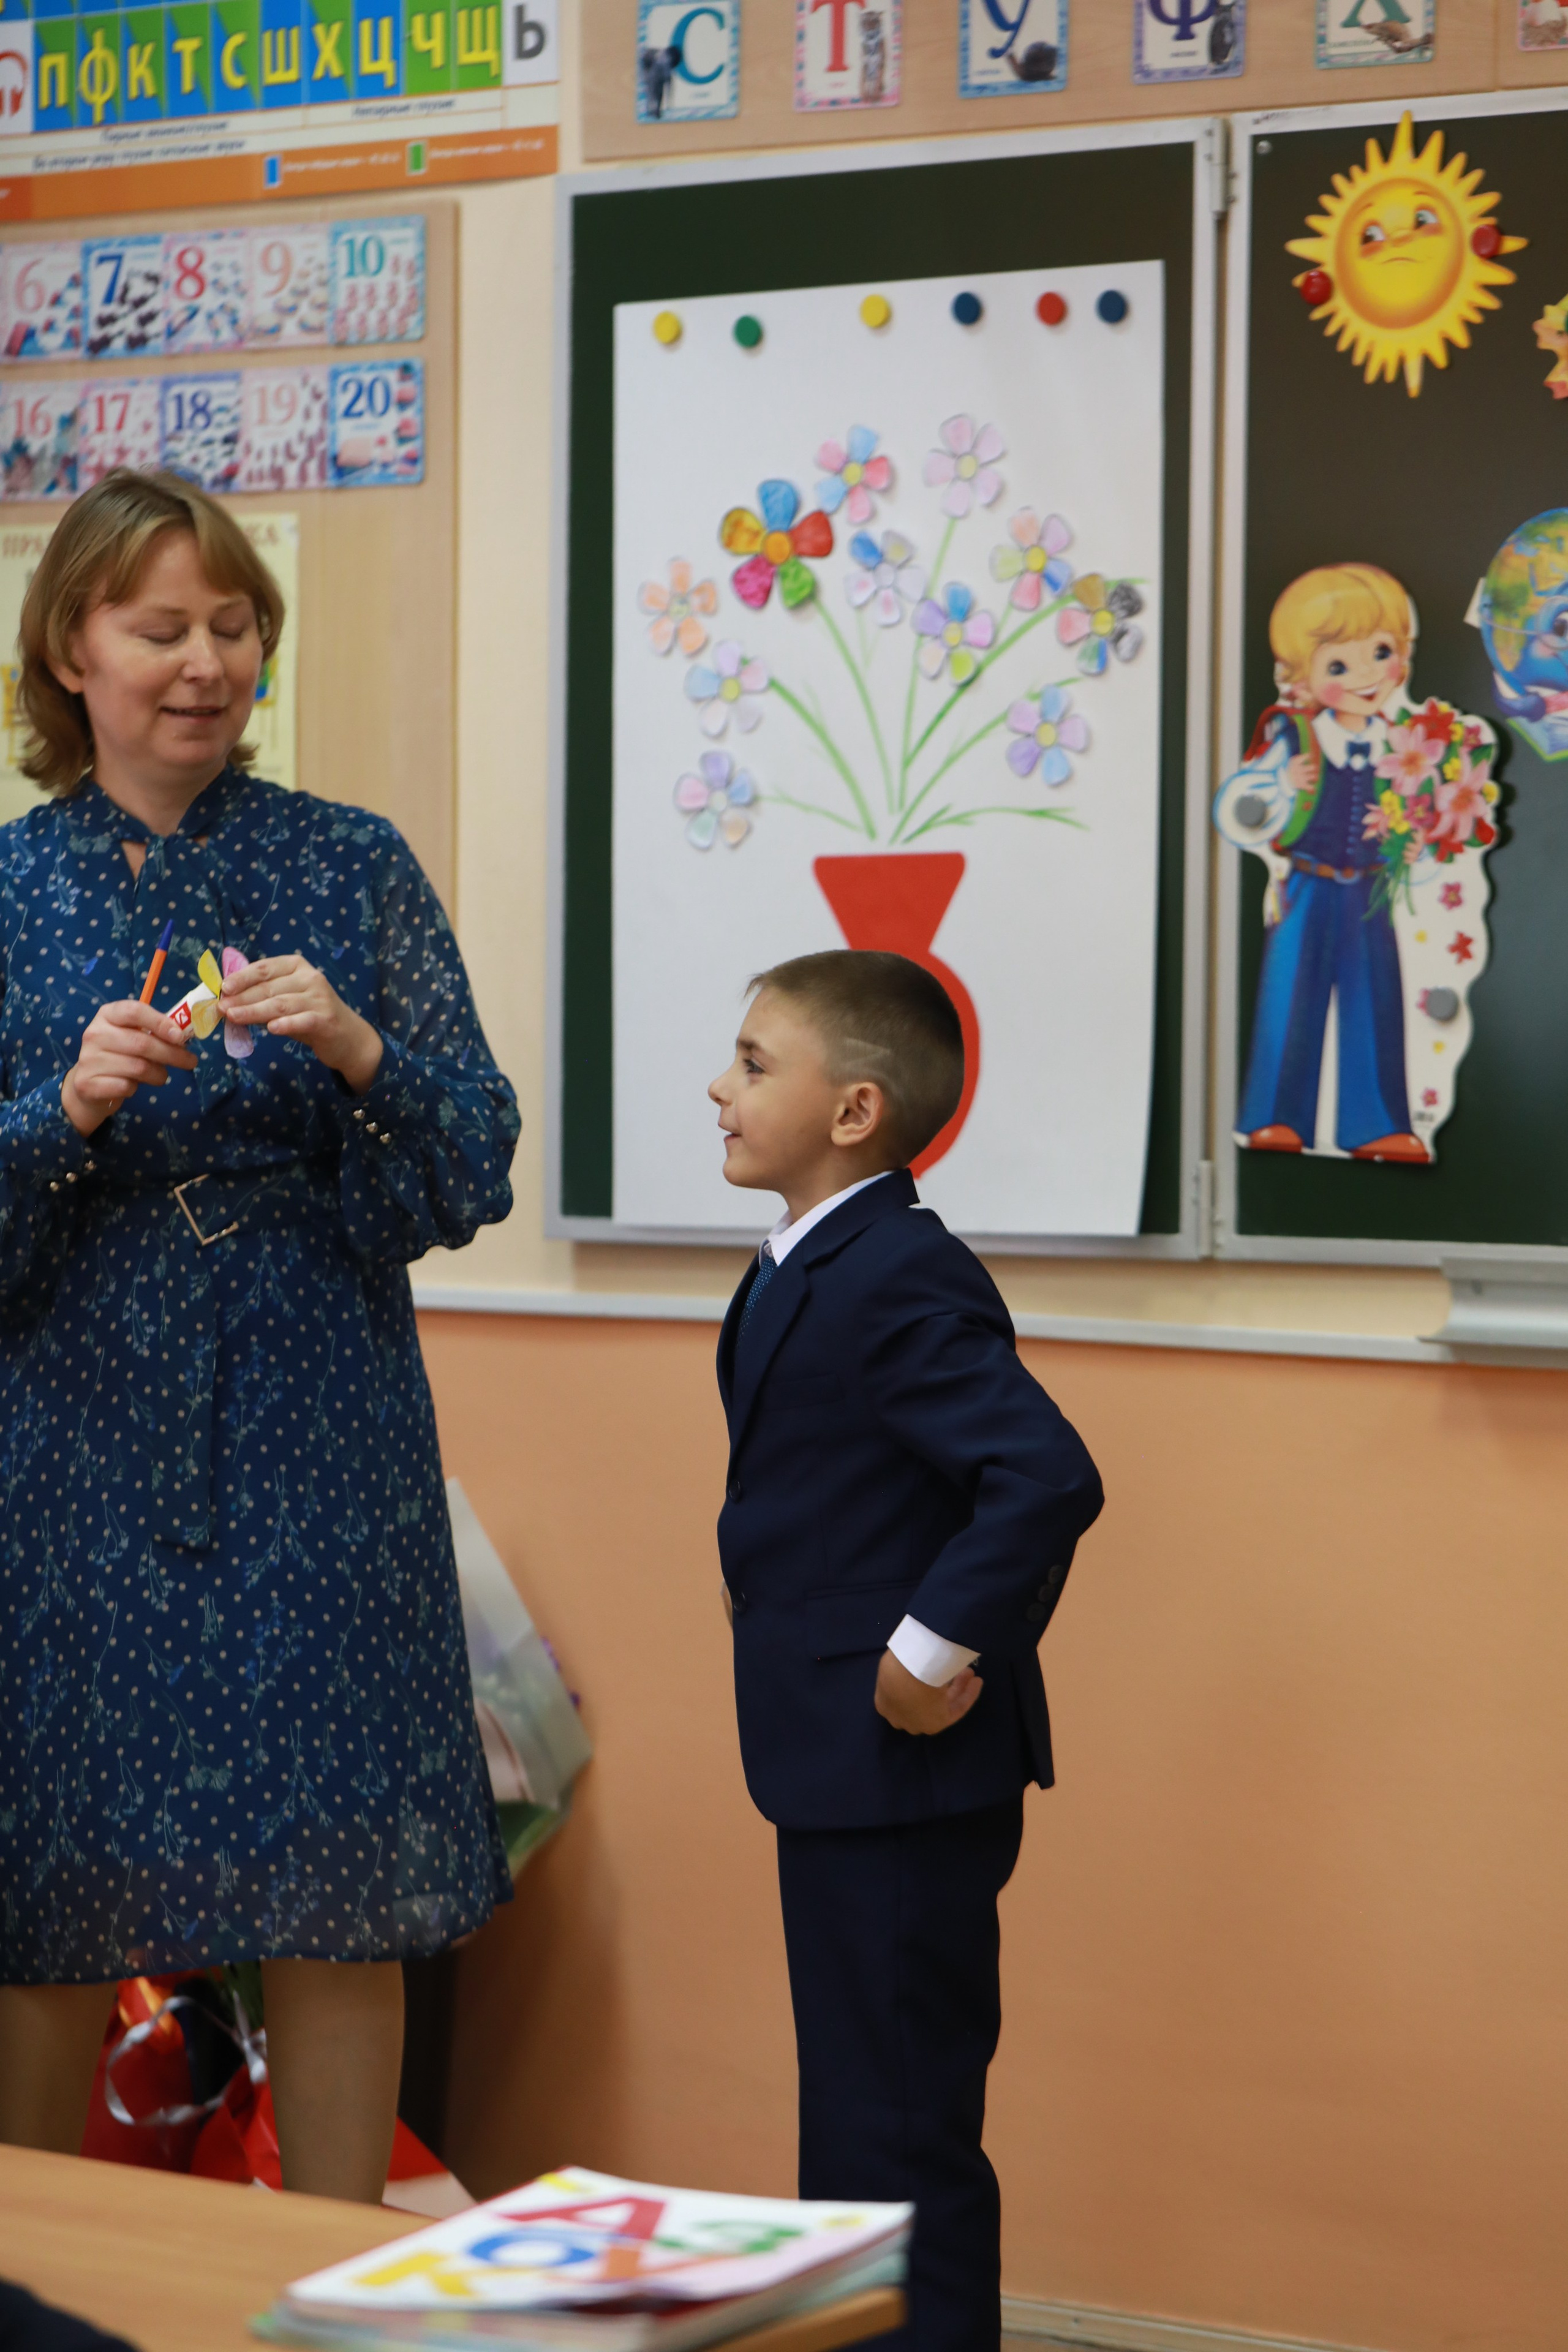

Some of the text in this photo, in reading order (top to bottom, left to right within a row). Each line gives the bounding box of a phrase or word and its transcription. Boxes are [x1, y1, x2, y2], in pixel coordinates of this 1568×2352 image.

[670, 7, 725, 85] С
[811, 0, 865, 72] Т
[15, 236, 385, 314] 6 7 8 9 10
[13, 375, 390, 438] 16 17 18 19 20
